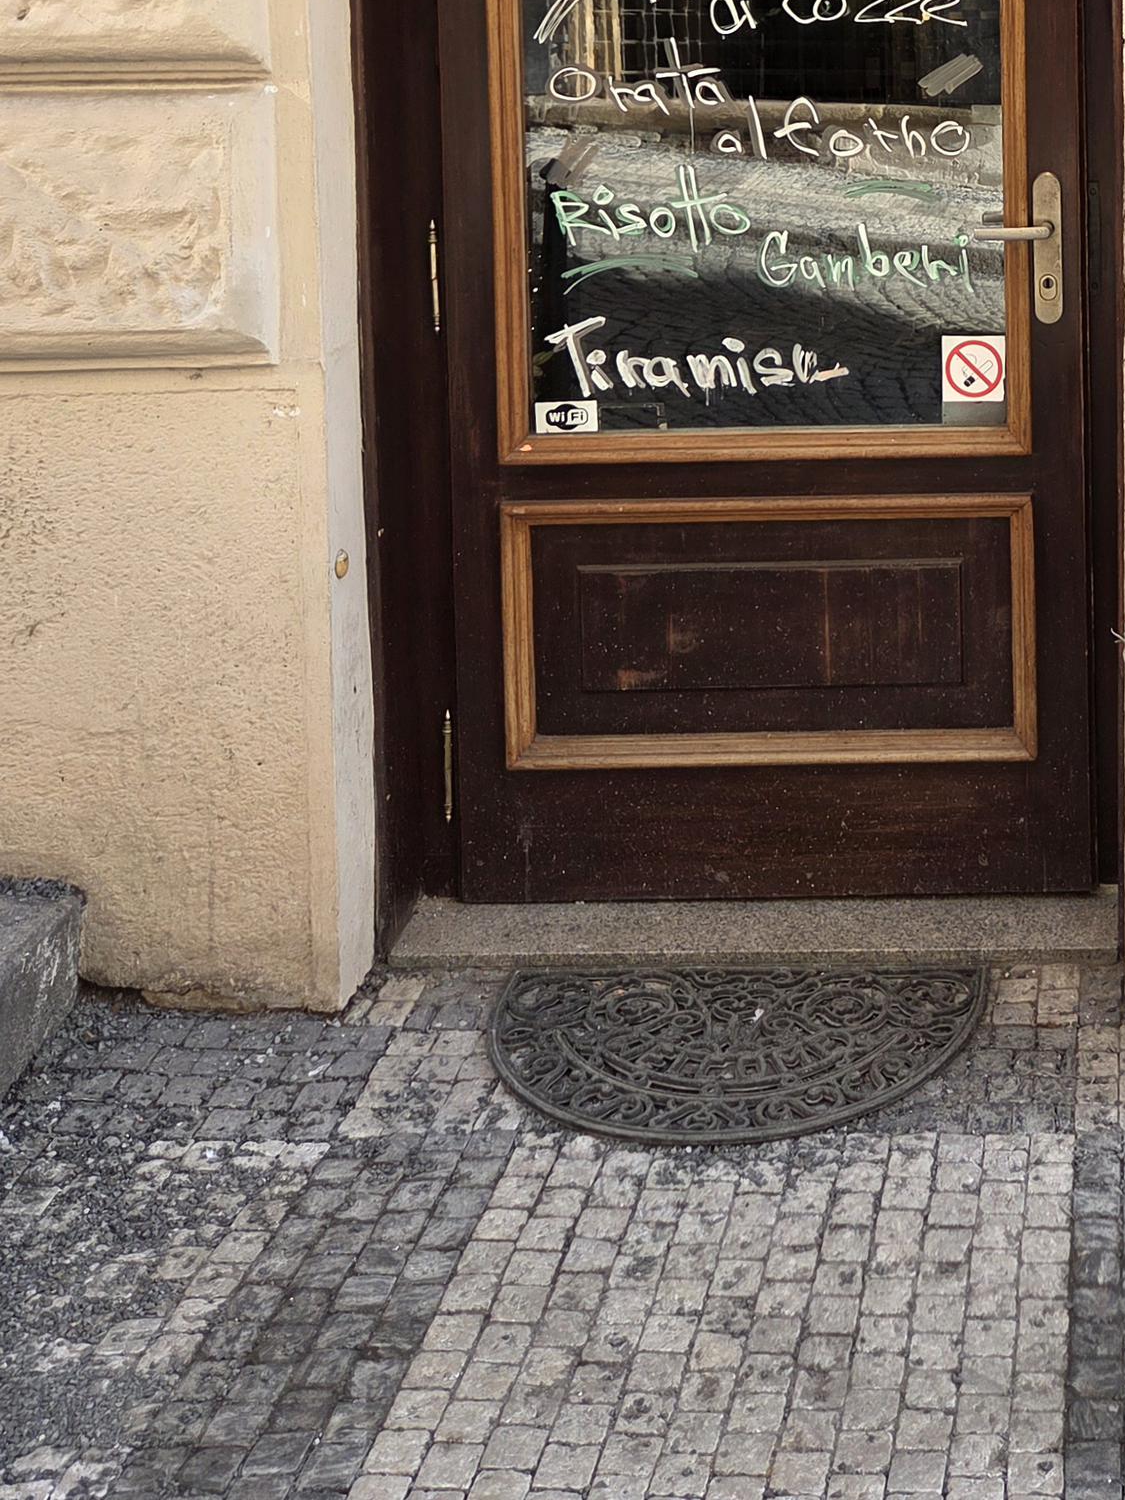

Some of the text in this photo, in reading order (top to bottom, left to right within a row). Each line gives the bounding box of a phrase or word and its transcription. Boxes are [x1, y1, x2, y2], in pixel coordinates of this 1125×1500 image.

[549, 37, 728, 116] Orata
[716, 96, 768, 159] al
[550, 165, 751, 253] Risotto
[757, 223, 976, 294] Gamberi
[545, 316, 850, 398] Tiramisu
